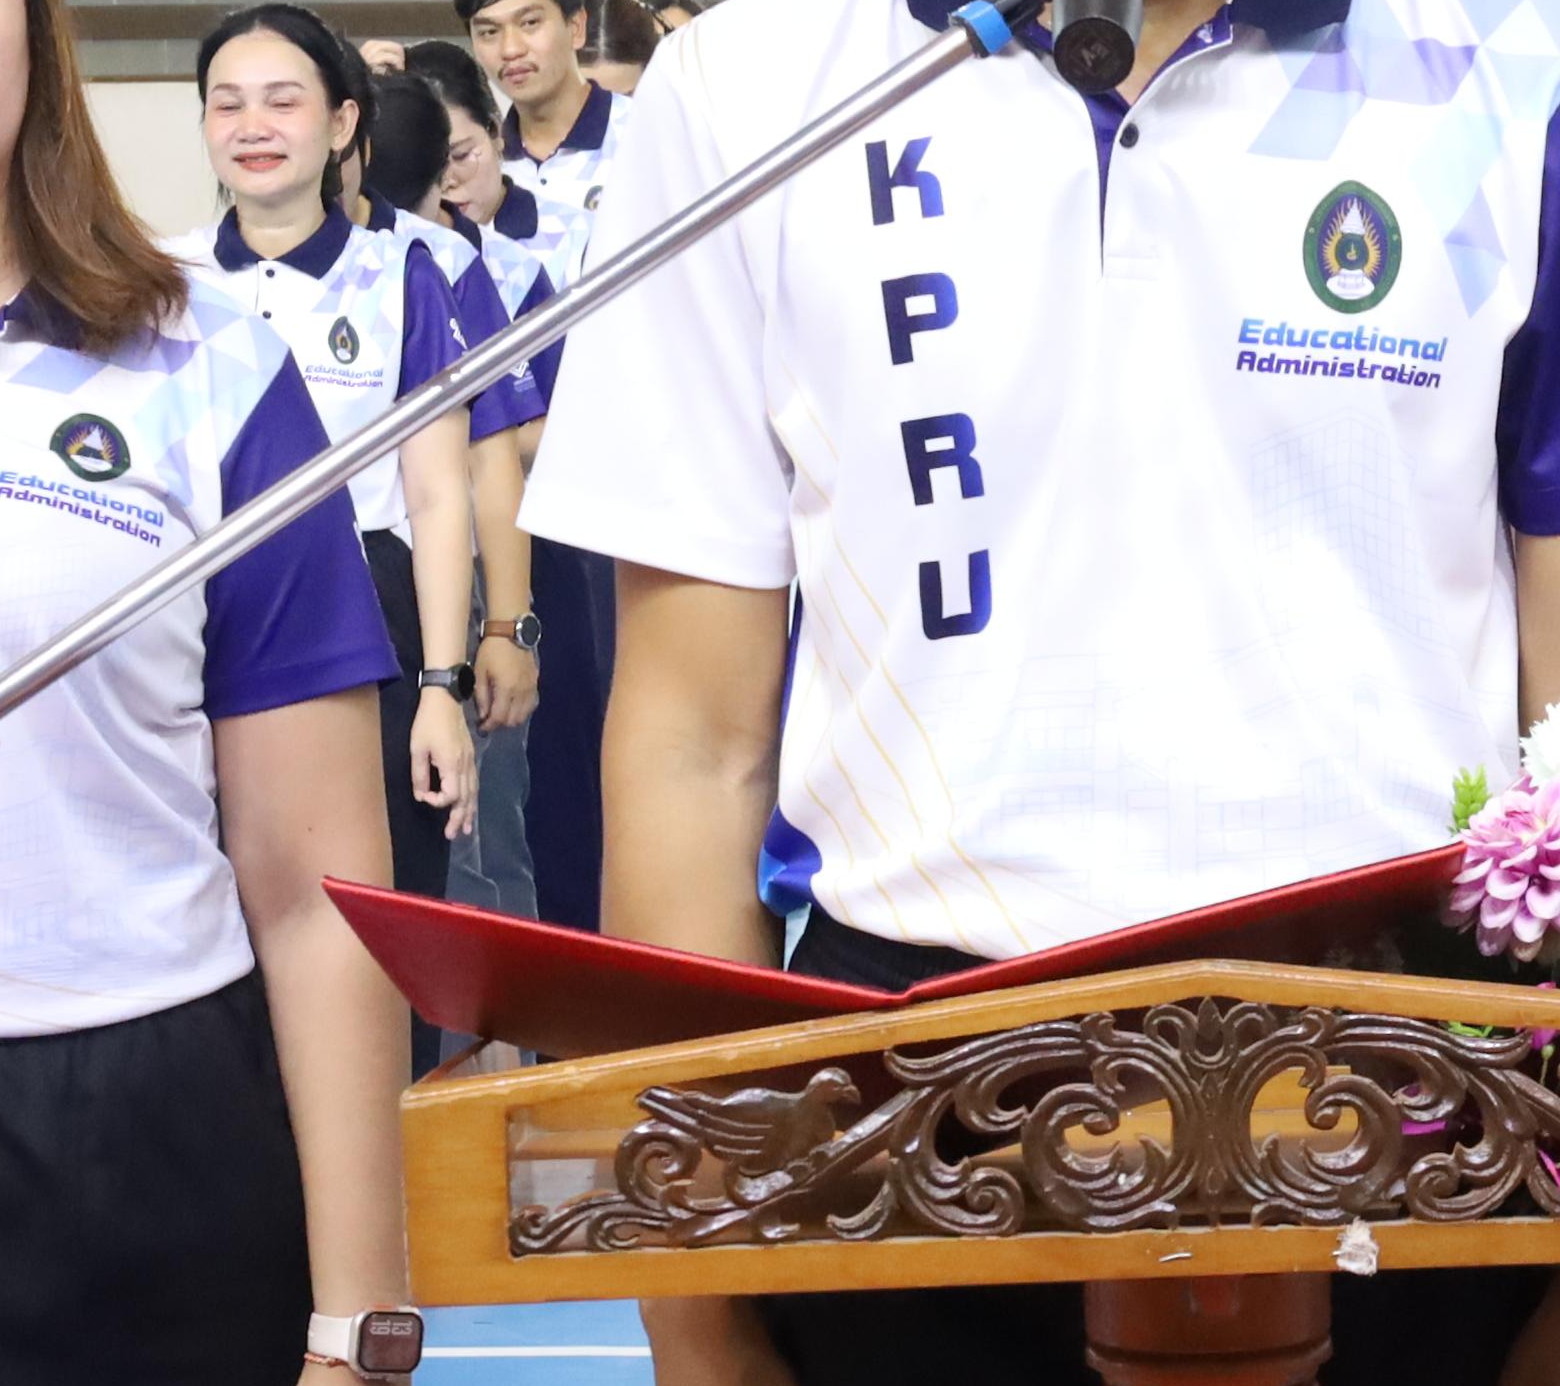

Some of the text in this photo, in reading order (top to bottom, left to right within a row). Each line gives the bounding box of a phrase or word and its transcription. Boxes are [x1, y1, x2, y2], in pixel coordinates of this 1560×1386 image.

[1238, 317, 1449, 363] Educational
[865, 136, 993, 641] KPRU
[1236, 350, 1441, 389] Administration
